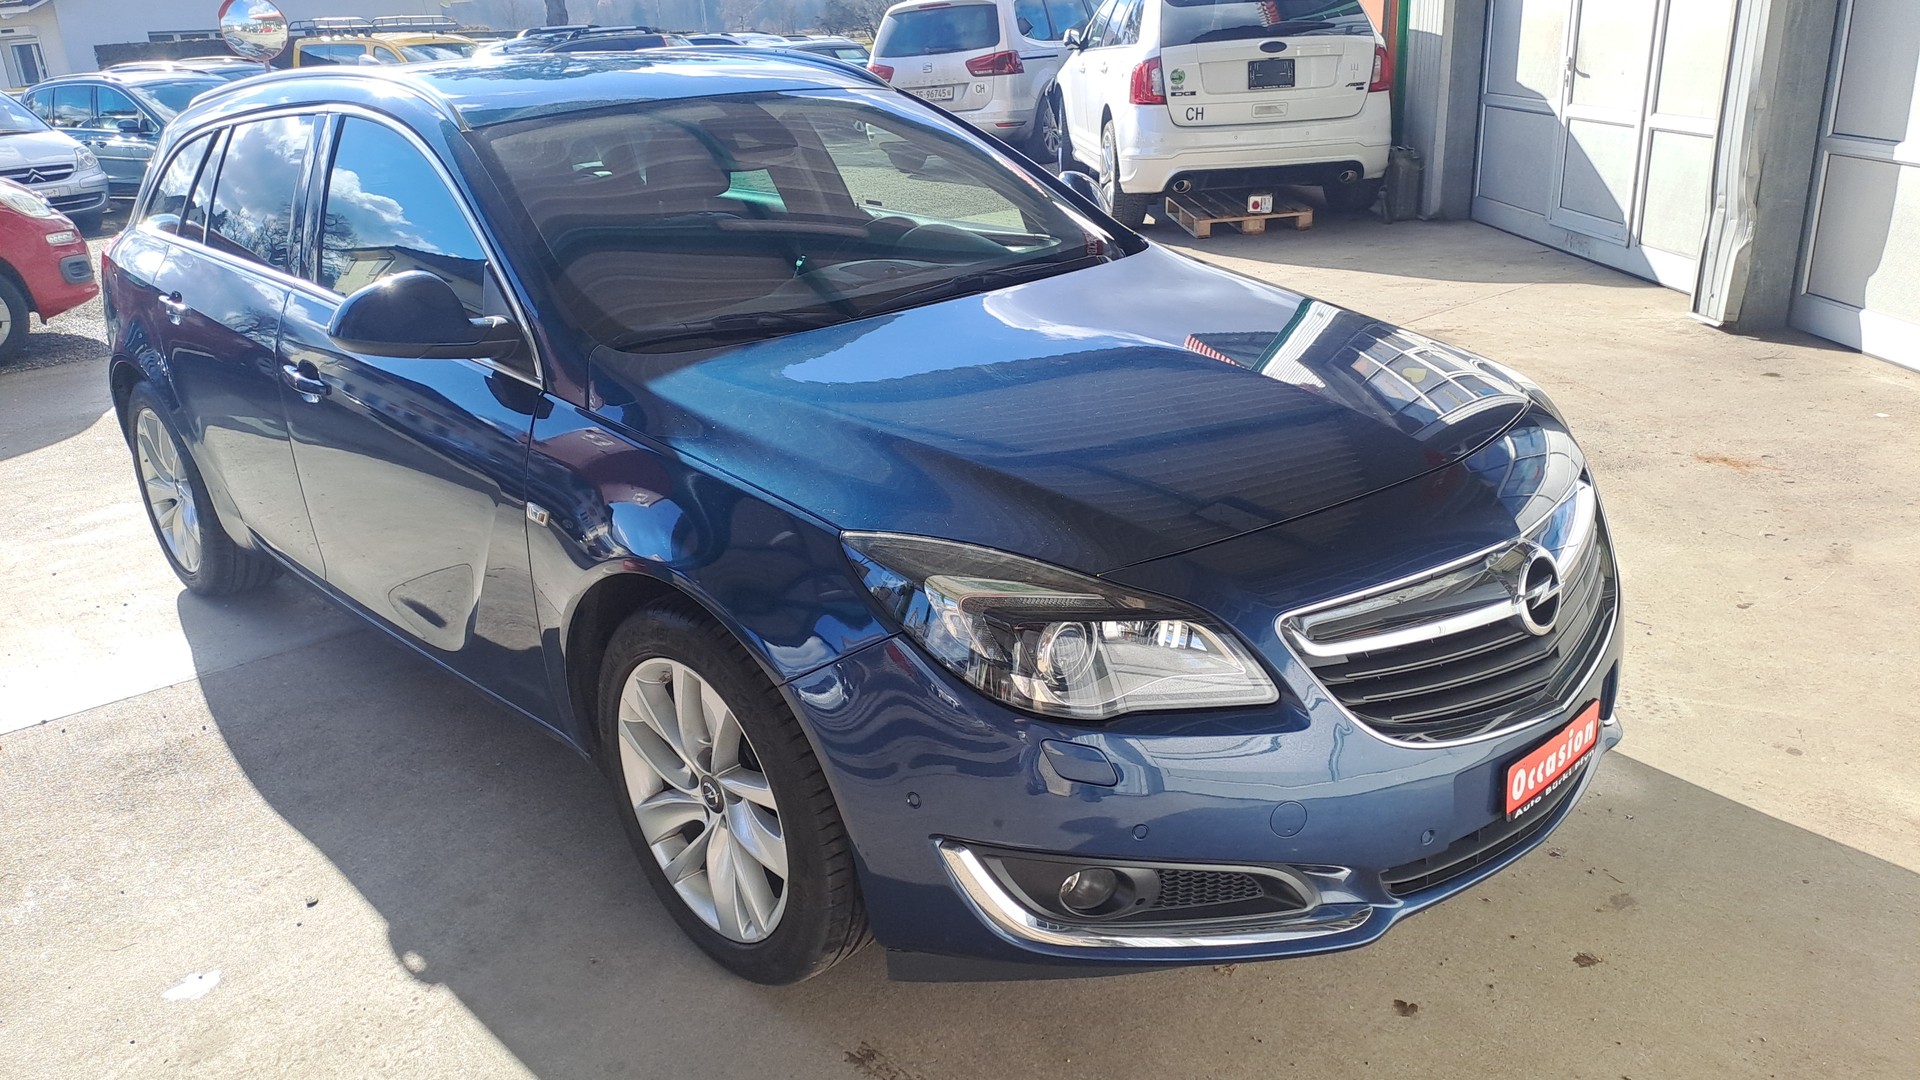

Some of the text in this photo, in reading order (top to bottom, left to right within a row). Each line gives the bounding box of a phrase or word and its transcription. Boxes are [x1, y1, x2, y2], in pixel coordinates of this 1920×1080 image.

[975, 84, 985, 94] CH
[1186, 107, 1204, 121] CH
[1512, 720, 1594, 801] Occasion
[1514, 796, 1542, 819] Auto
